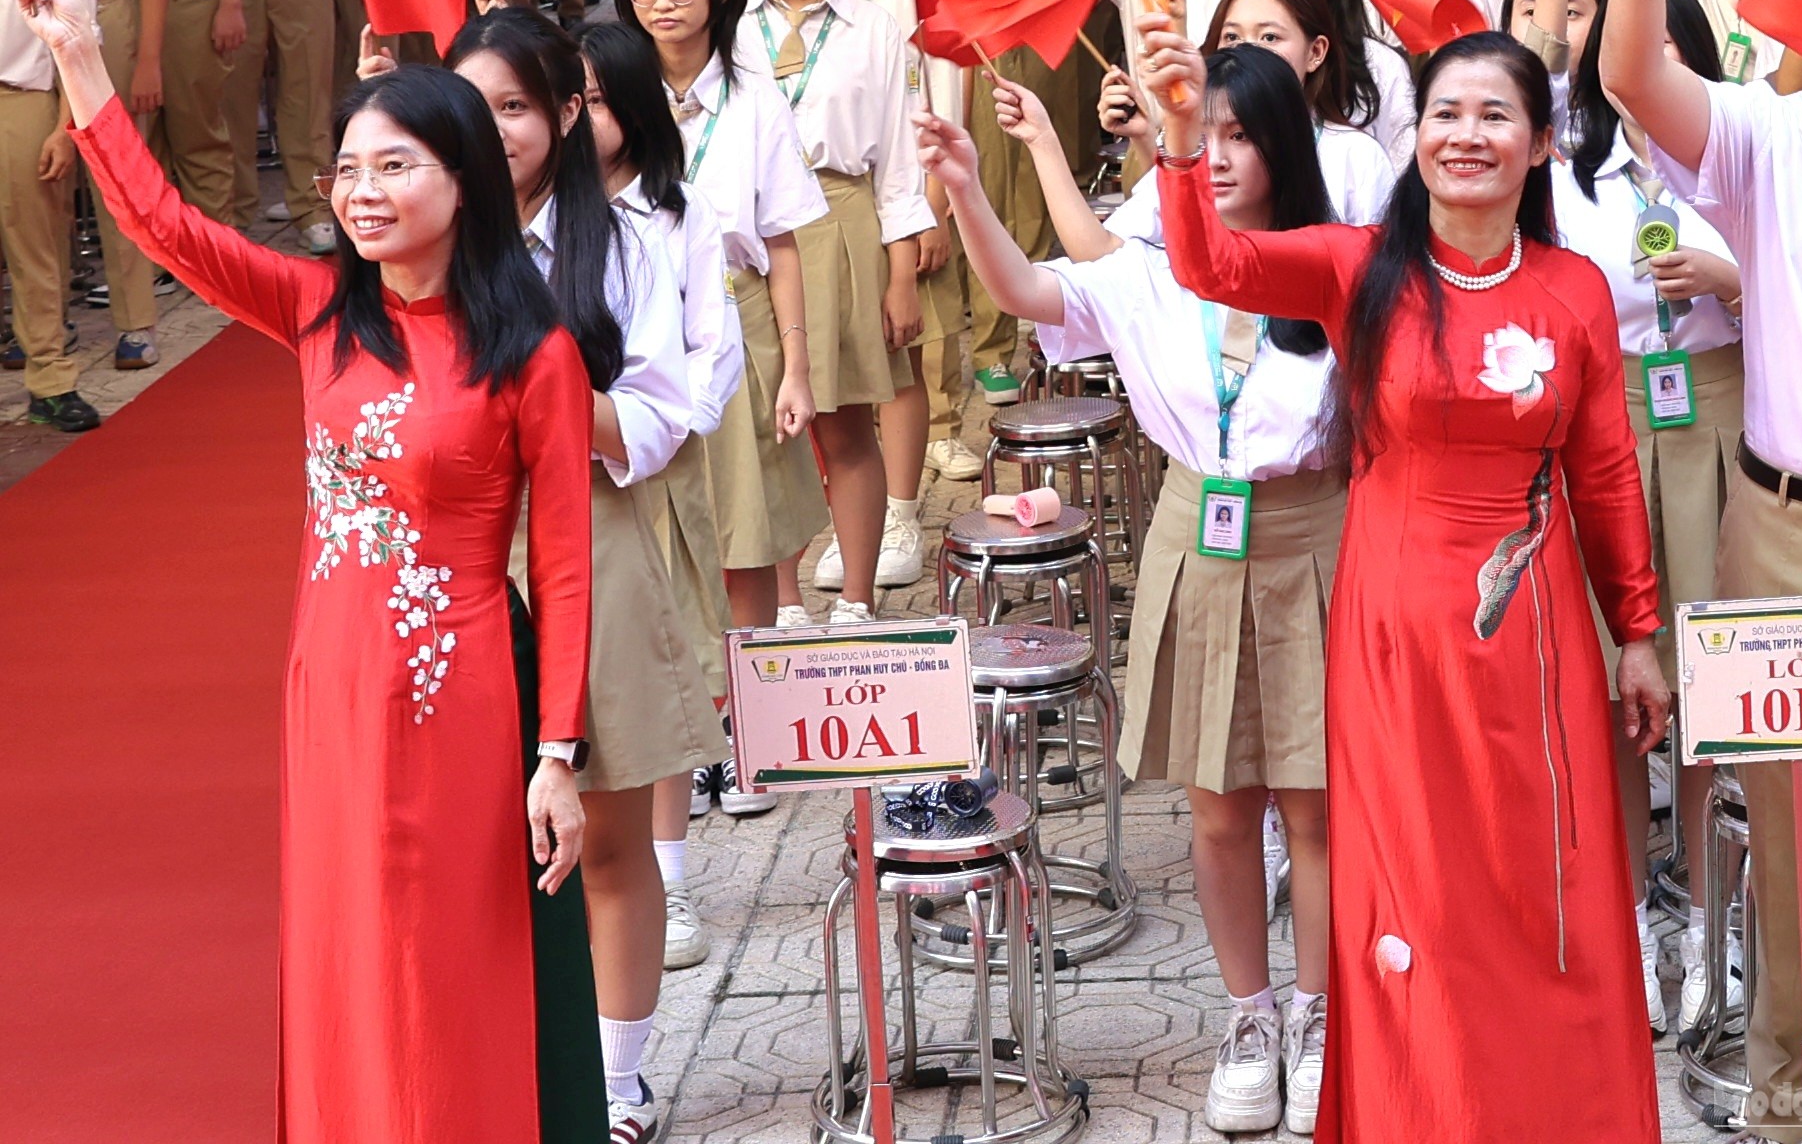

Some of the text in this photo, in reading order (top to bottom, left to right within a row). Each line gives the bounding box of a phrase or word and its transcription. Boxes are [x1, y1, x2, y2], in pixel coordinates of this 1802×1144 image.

[1752, 624, 1764, 635] SỞ
[1766, 623, 1786, 635] GIÁO
[1773, 637, 1792, 650] THPT
[807, 646, 936, 664] SỞ GIÁO DỤC VÀ ĐÀO TẠO HÀ NỘI
[795, 664, 826, 680] TRƯỜNG
[828, 665, 848, 678] THPT
[849, 664, 872, 676] PHAN
[873, 663, 889, 675] HUY
[914, 657, 937, 672] ĐỐNG
[938, 659, 950, 670] ĐA
[824, 679, 887, 706] LỚP
[789, 711, 928, 762] 10A1
